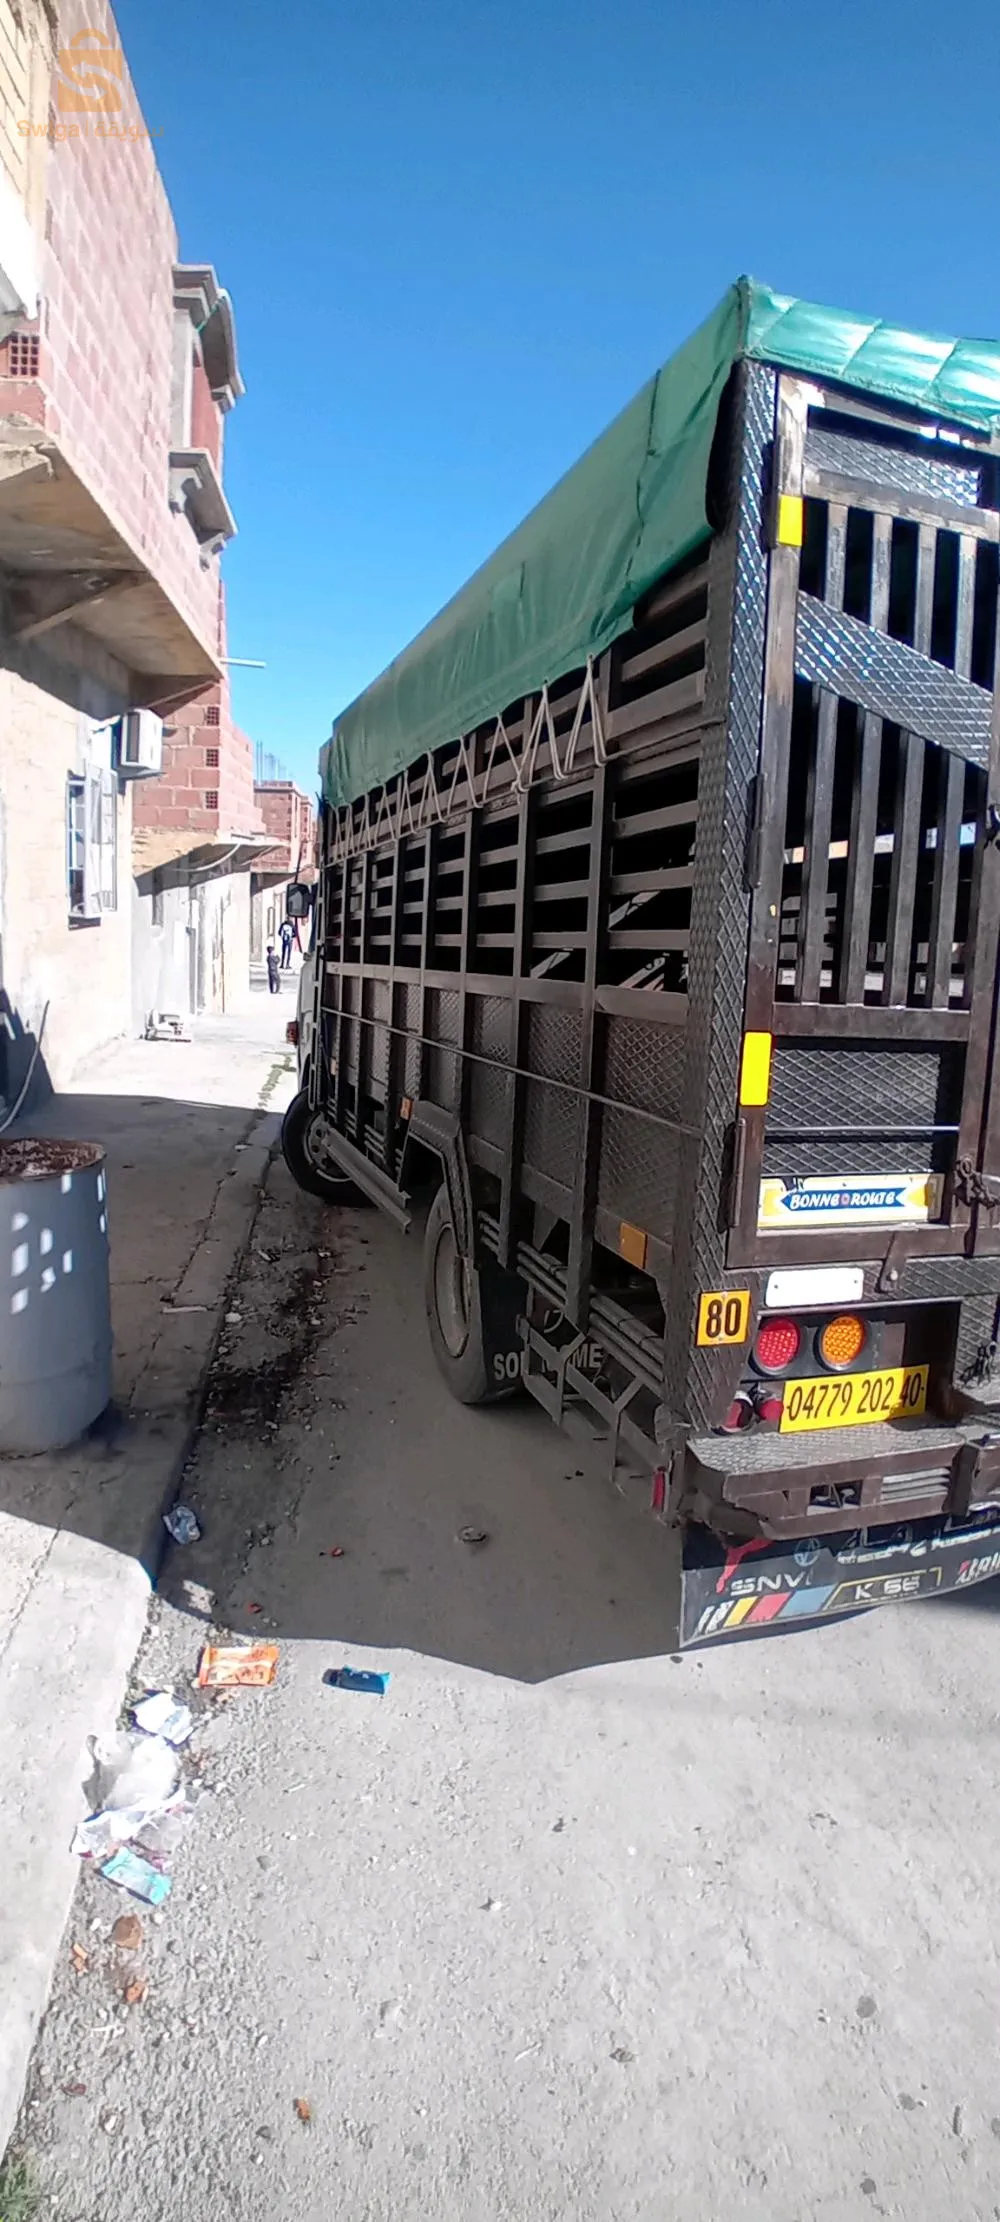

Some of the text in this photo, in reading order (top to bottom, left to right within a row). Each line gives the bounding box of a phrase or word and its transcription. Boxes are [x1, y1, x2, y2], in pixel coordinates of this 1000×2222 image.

[790, 1191, 895, 1210] BONNE ROUTE
[705, 1298, 742, 1338] 80
[788, 1381, 853, 1421] 04779
[856, 1376, 895, 1414] 202
[855, 1582, 874, 1600] K
